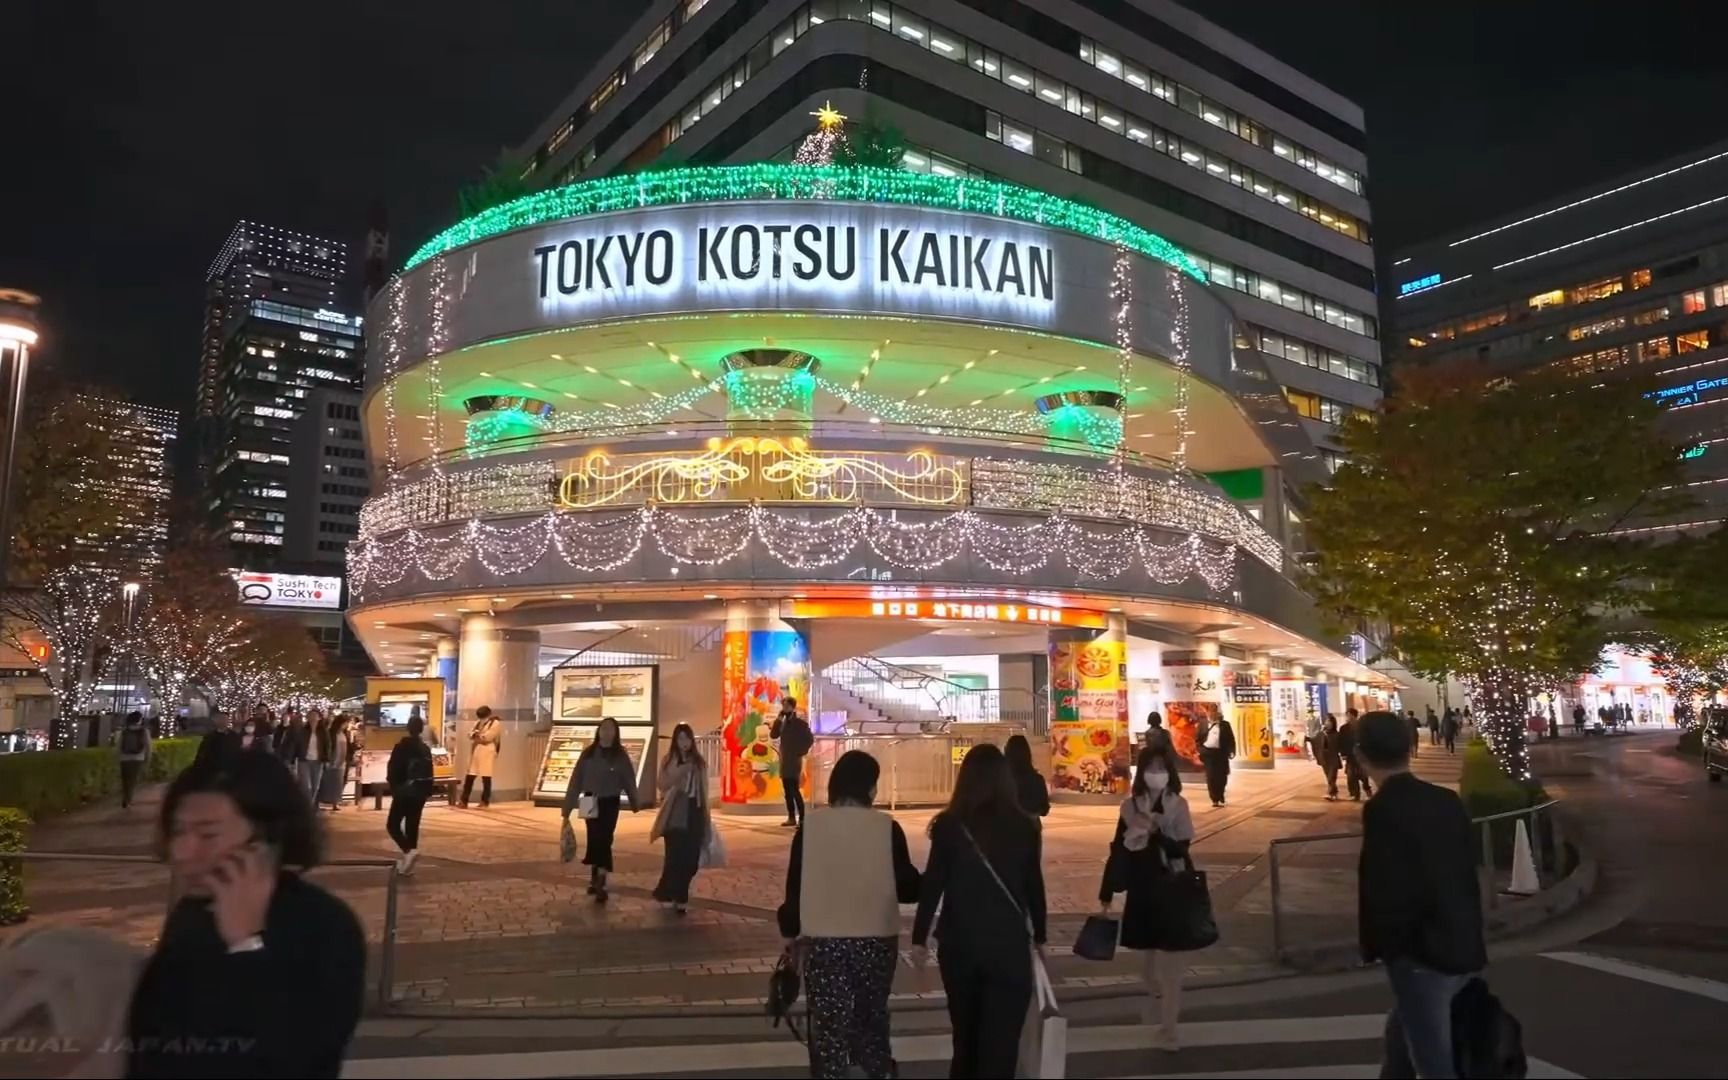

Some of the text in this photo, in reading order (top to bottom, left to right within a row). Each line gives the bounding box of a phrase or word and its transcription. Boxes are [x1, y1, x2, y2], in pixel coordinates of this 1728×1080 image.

[534, 224, 1054, 301] TOKYO KOTSU KAIKAN
[1696, 378, 1728, 390] GATE
[313, 580, 337, 590] Tech
